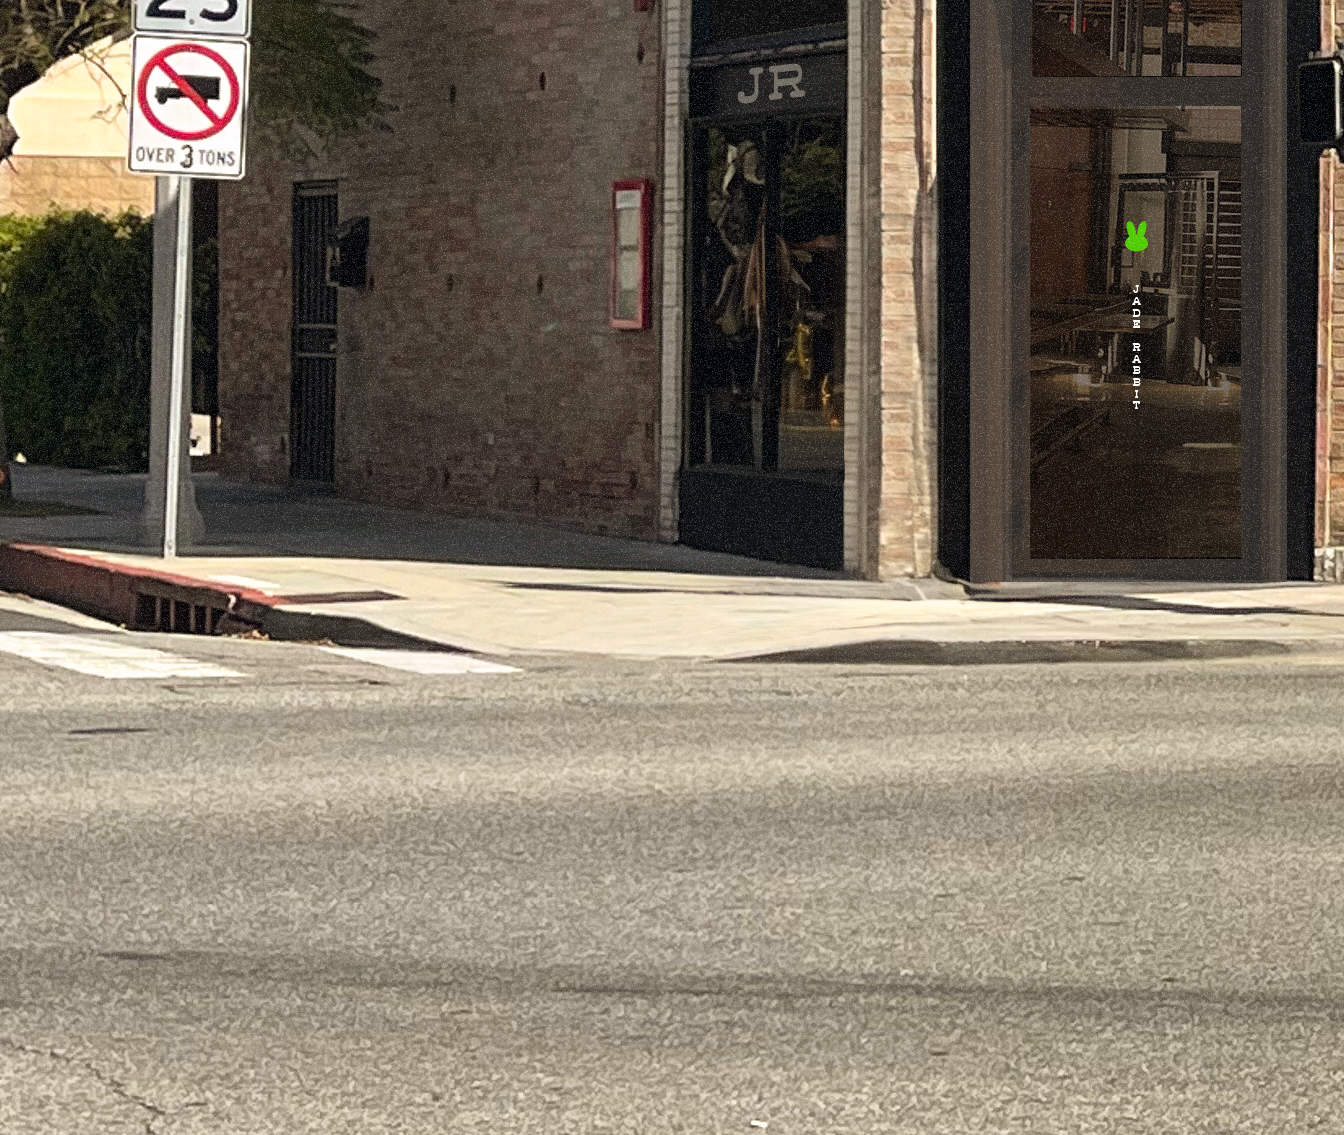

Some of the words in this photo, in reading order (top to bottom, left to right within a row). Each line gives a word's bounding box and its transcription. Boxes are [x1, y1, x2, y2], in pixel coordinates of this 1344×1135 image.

[737, 62, 806, 104] JR
[136, 146, 175, 164] OVER
[179, 144, 194, 169] 3
[198, 149, 236, 167] TONS
[1131, 284, 1142, 329] JADE
[1131, 342, 1142, 410] RABBIT
